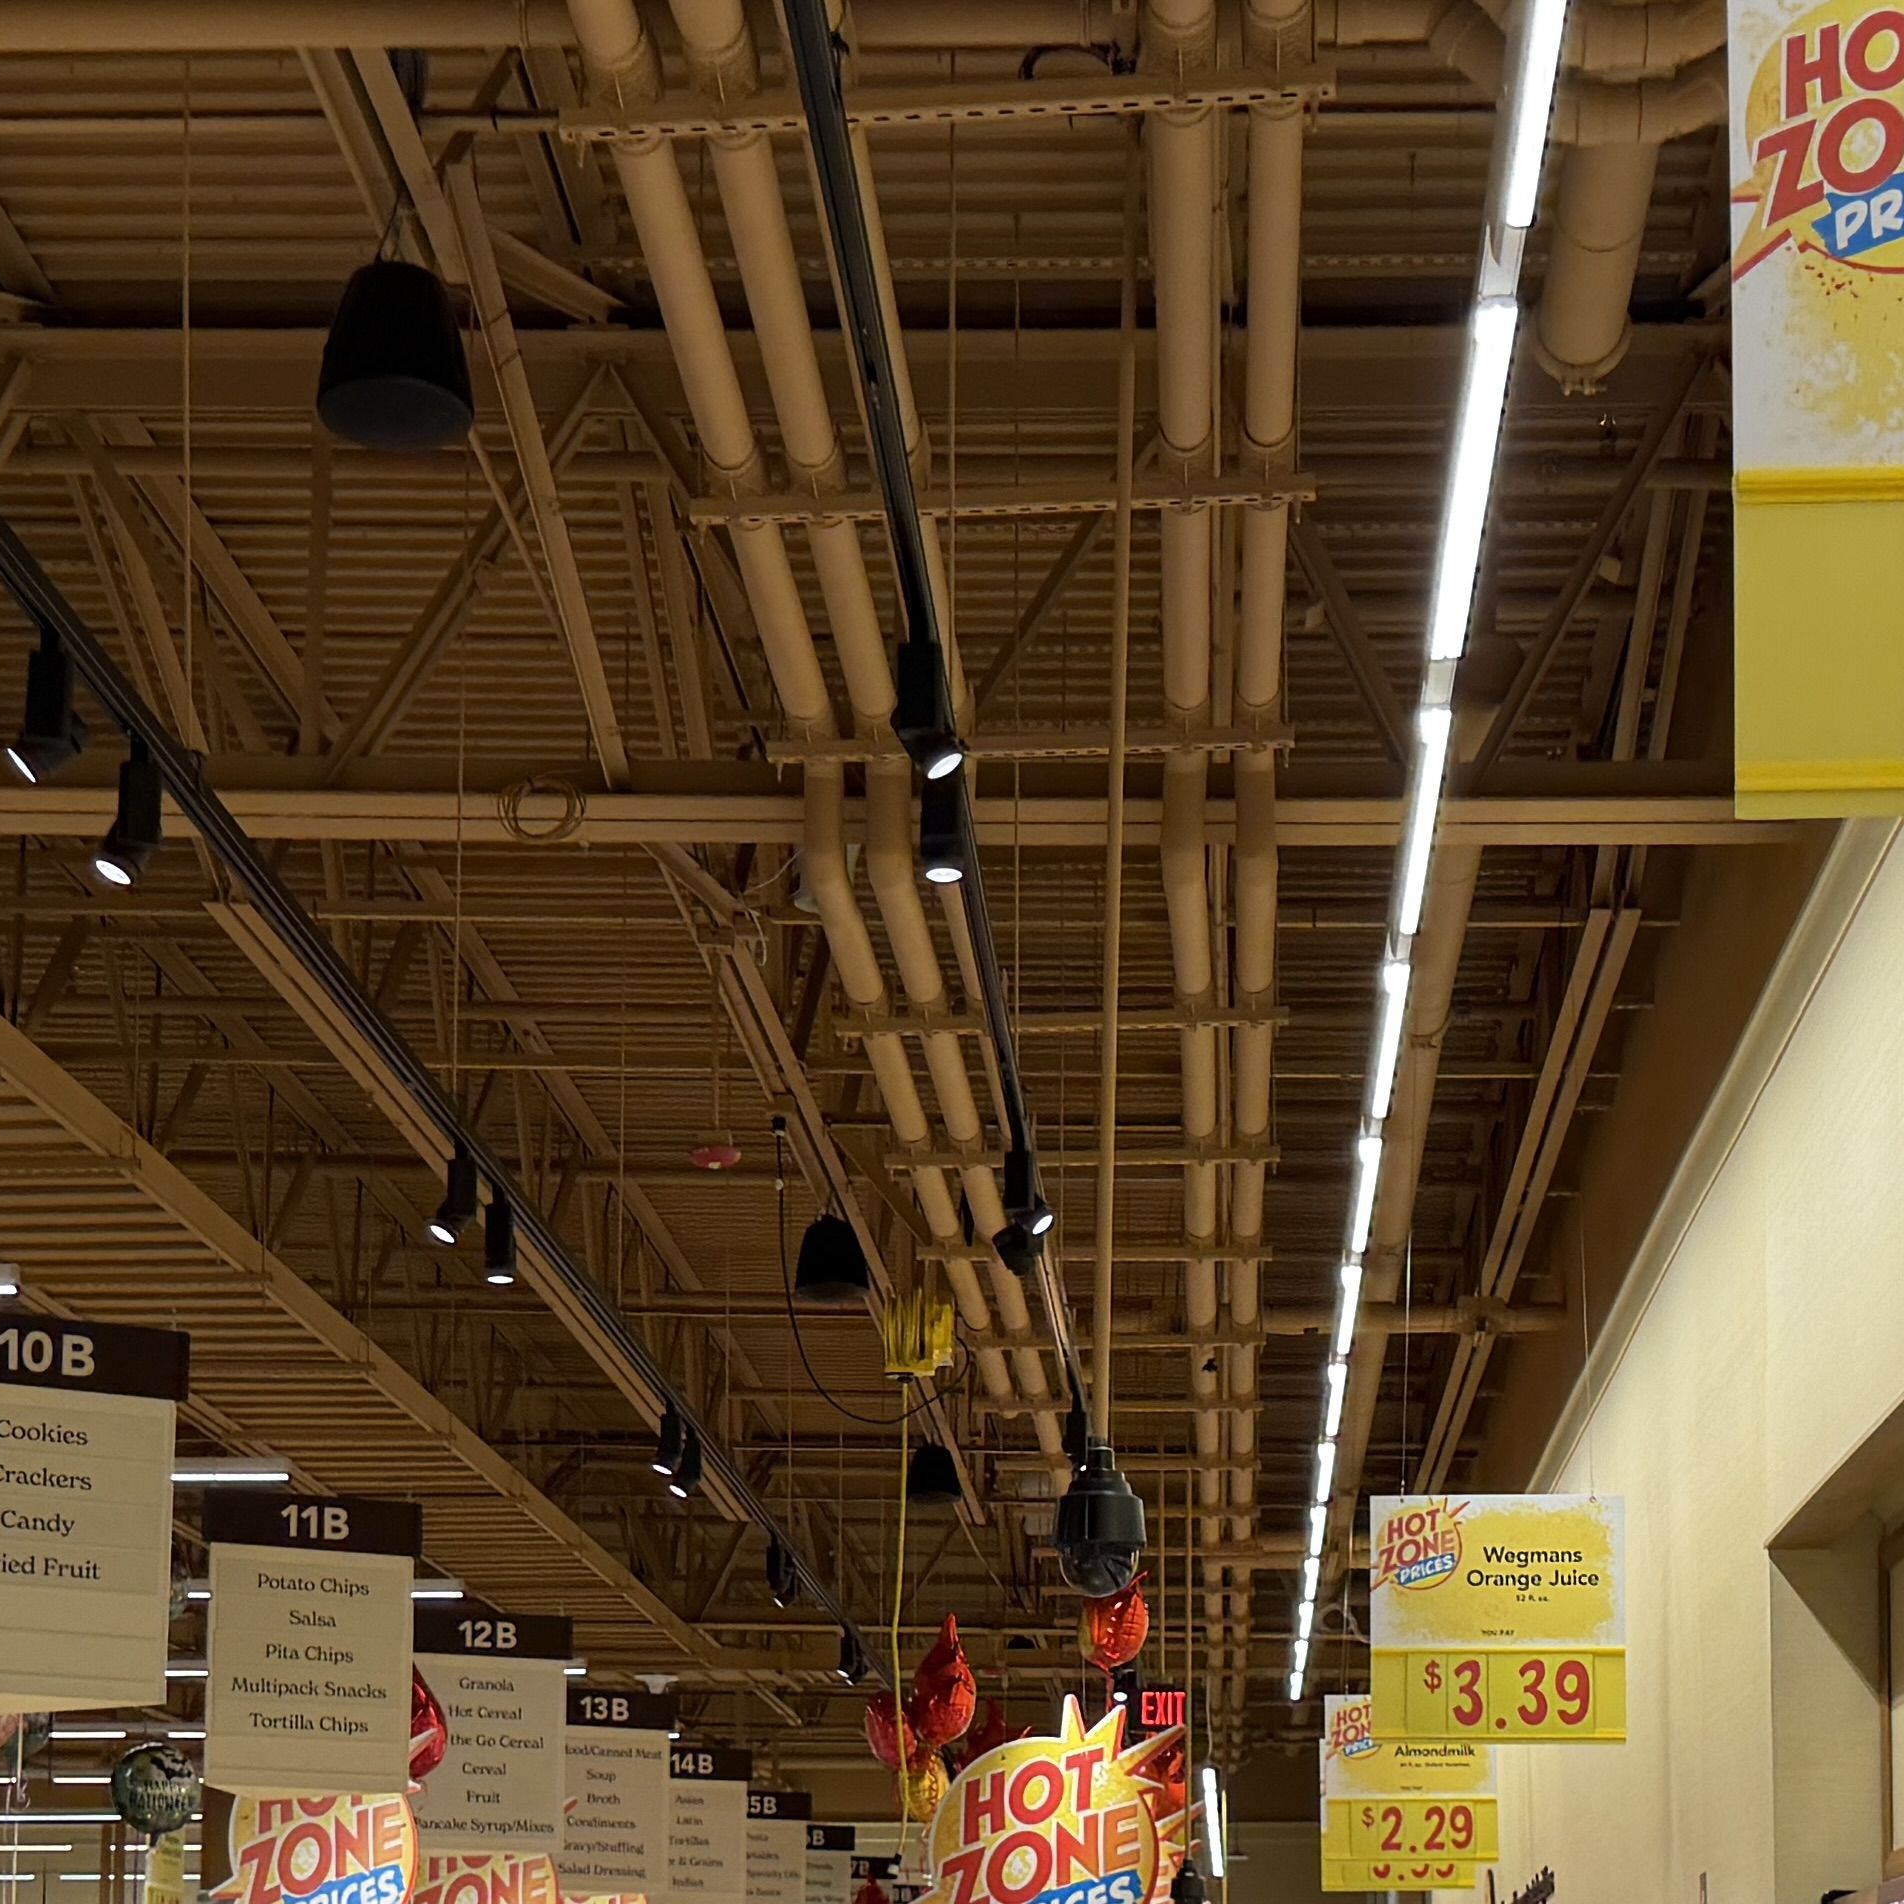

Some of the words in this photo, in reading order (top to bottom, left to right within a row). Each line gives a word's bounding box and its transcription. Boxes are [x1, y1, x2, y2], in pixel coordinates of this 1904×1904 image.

[0, 1510, 75, 1537] Candy
[281, 1505, 349, 1541] 11B
[1386, 1508, 1442, 1543] HOT
[1378, 1530, 1456, 1574] ZONE
[1483, 1546, 1583, 1564] Wegmans
[43, 1557, 101, 1580] Fruit
[1400, 1554, 1454, 1583] PRICES
[257, 1573, 316, 1594] Potato
[320, 1577, 370, 1598] Chips
[1467, 1569, 1542, 1592] Orange
[1549, 1569, 1599, 1587] Juice
[288, 1610, 337, 1628] Salsa
[265, 1643, 299, 1661] Pita
[304, 1646, 354, 1666] Chips
[231, 1677, 319, 1698] Multipack
[324, 1681, 387, 1700] Snacks
[459, 1677, 515, 1692] Granola
[448, 1705, 474, 1719] Hot
[478, 1706, 523, 1721] Cereal
[1142, 1692, 1186, 1726] EXIT
[249, 1712, 315, 1732] Tortilla
[319, 1716, 369, 1735] Chips
[450, 1734, 472, 1748] the
[475, 1735, 496, 1749] Go
[501, 1735, 544, 1750] Cereal
[1394, 1745, 1475, 1757] Almondmilk
[462, 1762, 507, 1776] Cereal
[466, 1790, 501, 1804] Fruit
[963, 1748, 1104, 1846] HOT
[470, 1819, 555, 1835] Syrup/Mixes
